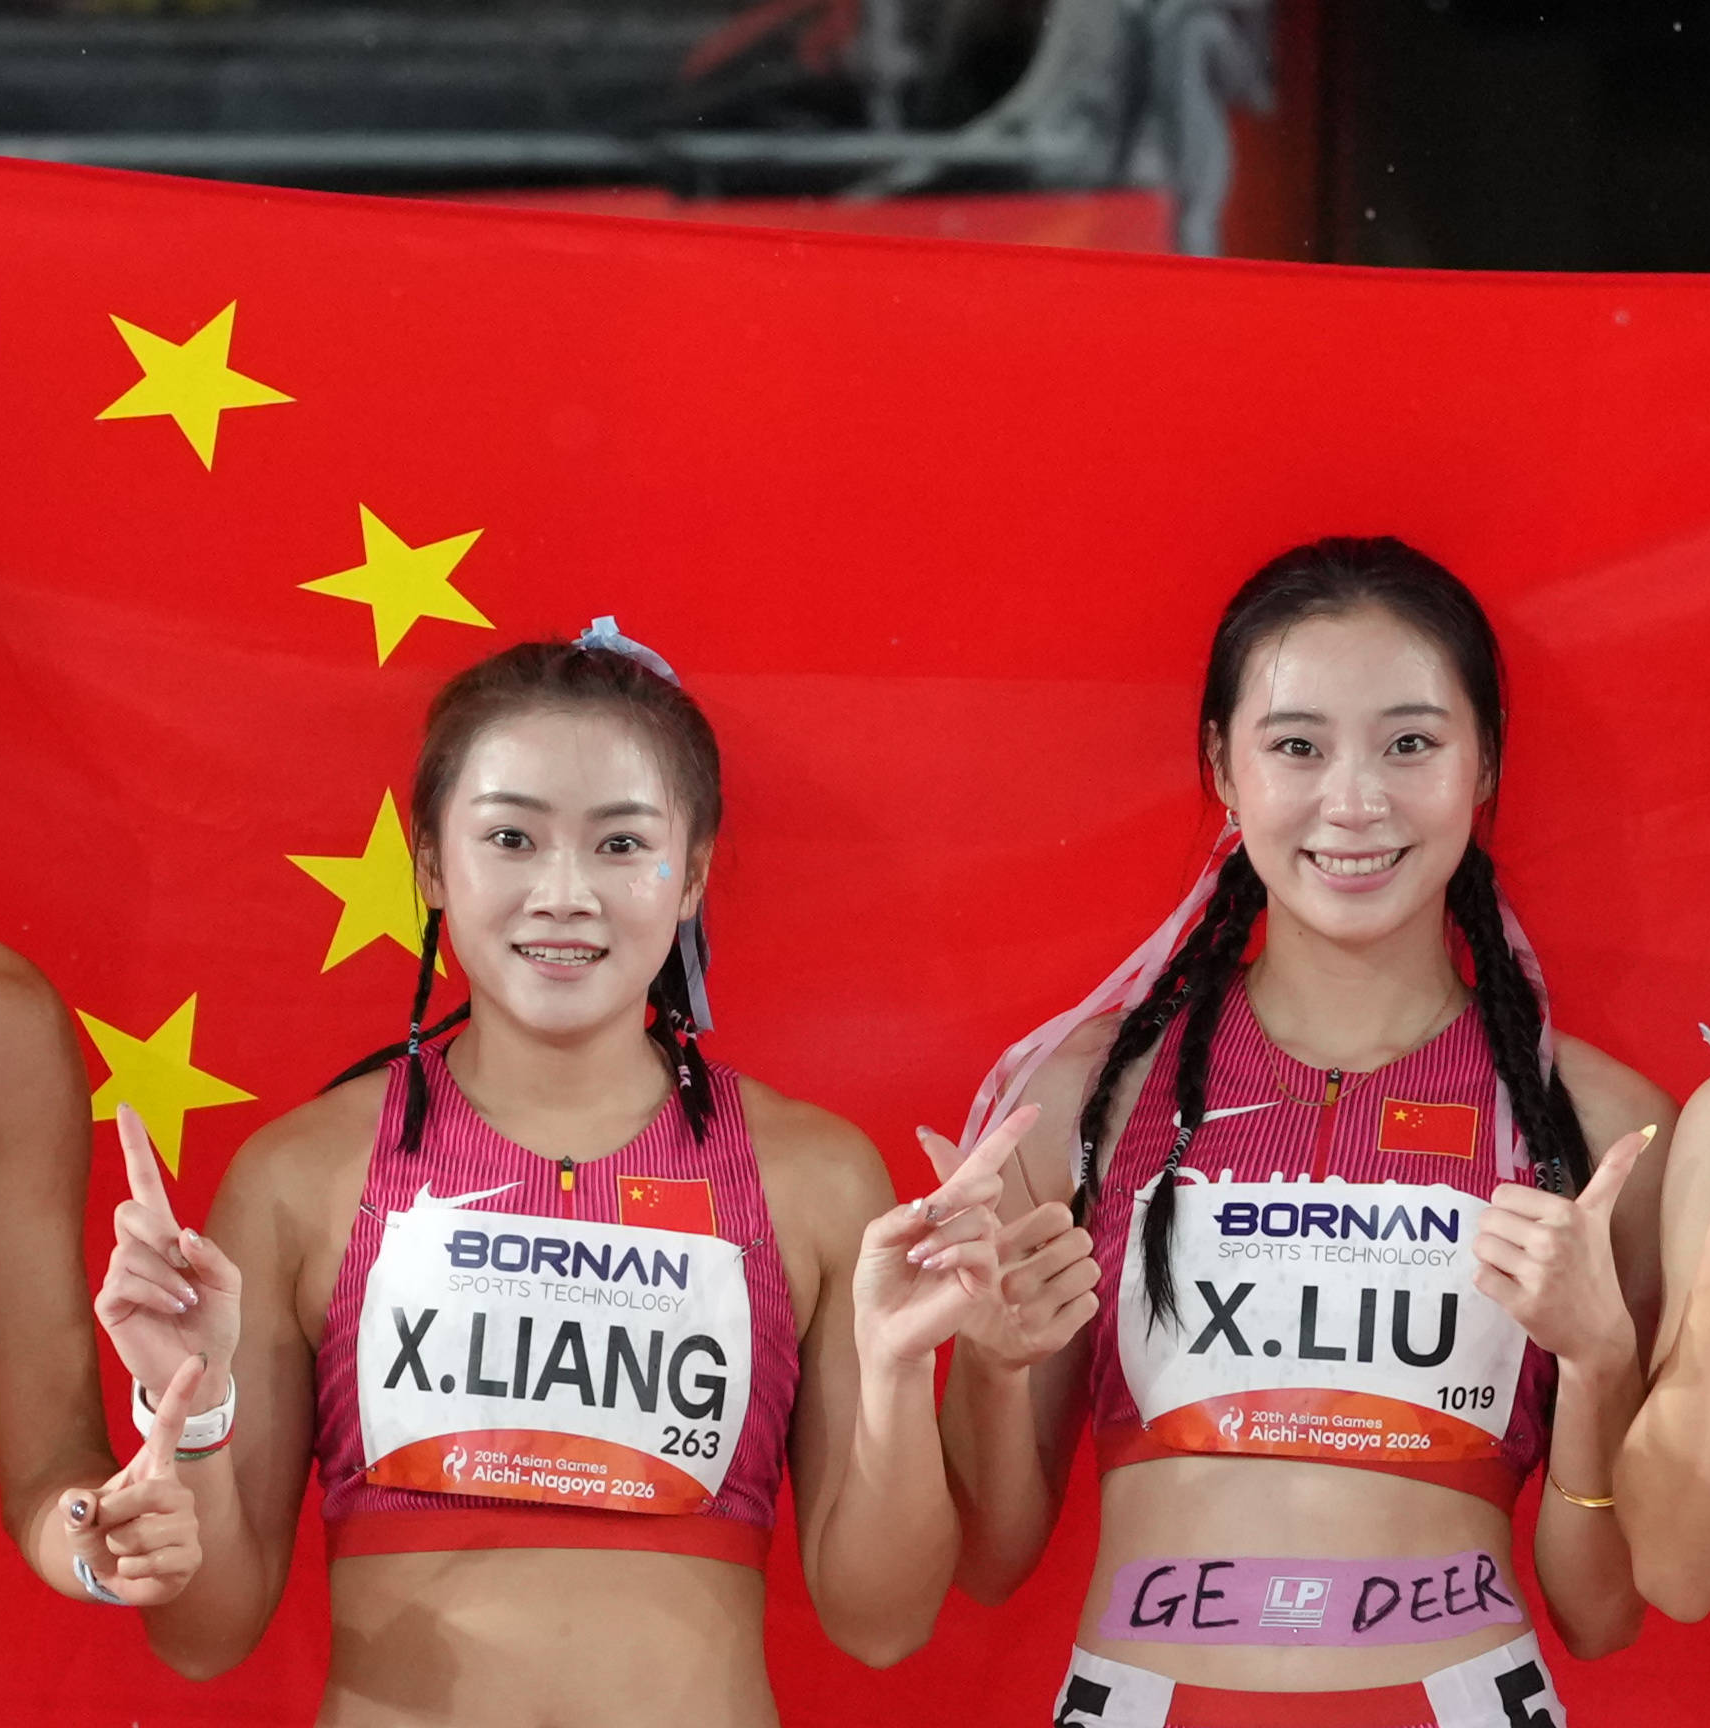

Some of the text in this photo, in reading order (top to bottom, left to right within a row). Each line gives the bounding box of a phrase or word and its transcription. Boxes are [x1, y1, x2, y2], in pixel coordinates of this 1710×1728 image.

[1213, 1202, 1459, 1243] BORNAN
[444, 1230, 689, 1290] BORNAN
[1218, 1242, 1457, 1267] SPORTS TECHNOLOGY
[448, 1275, 685, 1313] SPORTS TECHNOLOGY
[1188, 1281, 1459, 1368] X.LIU
[383, 1306, 728, 1421] X.LIANG
[1436, 1386, 1495, 1410] 1019
[1251, 1411, 1383, 1429] 20th Asian Games
[660, 1426, 721, 1460] 263
[1249, 1425, 1431, 1450] Aichi-Nagoya 2026
[474, 1451, 608, 1474] 20th Asian Games
[472, 1465, 655, 1498] Aichi-Nagoya 2026
[1130, 1554, 1515, 1633] GE DEER
[1270, 1580, 1324, 1608] LP
